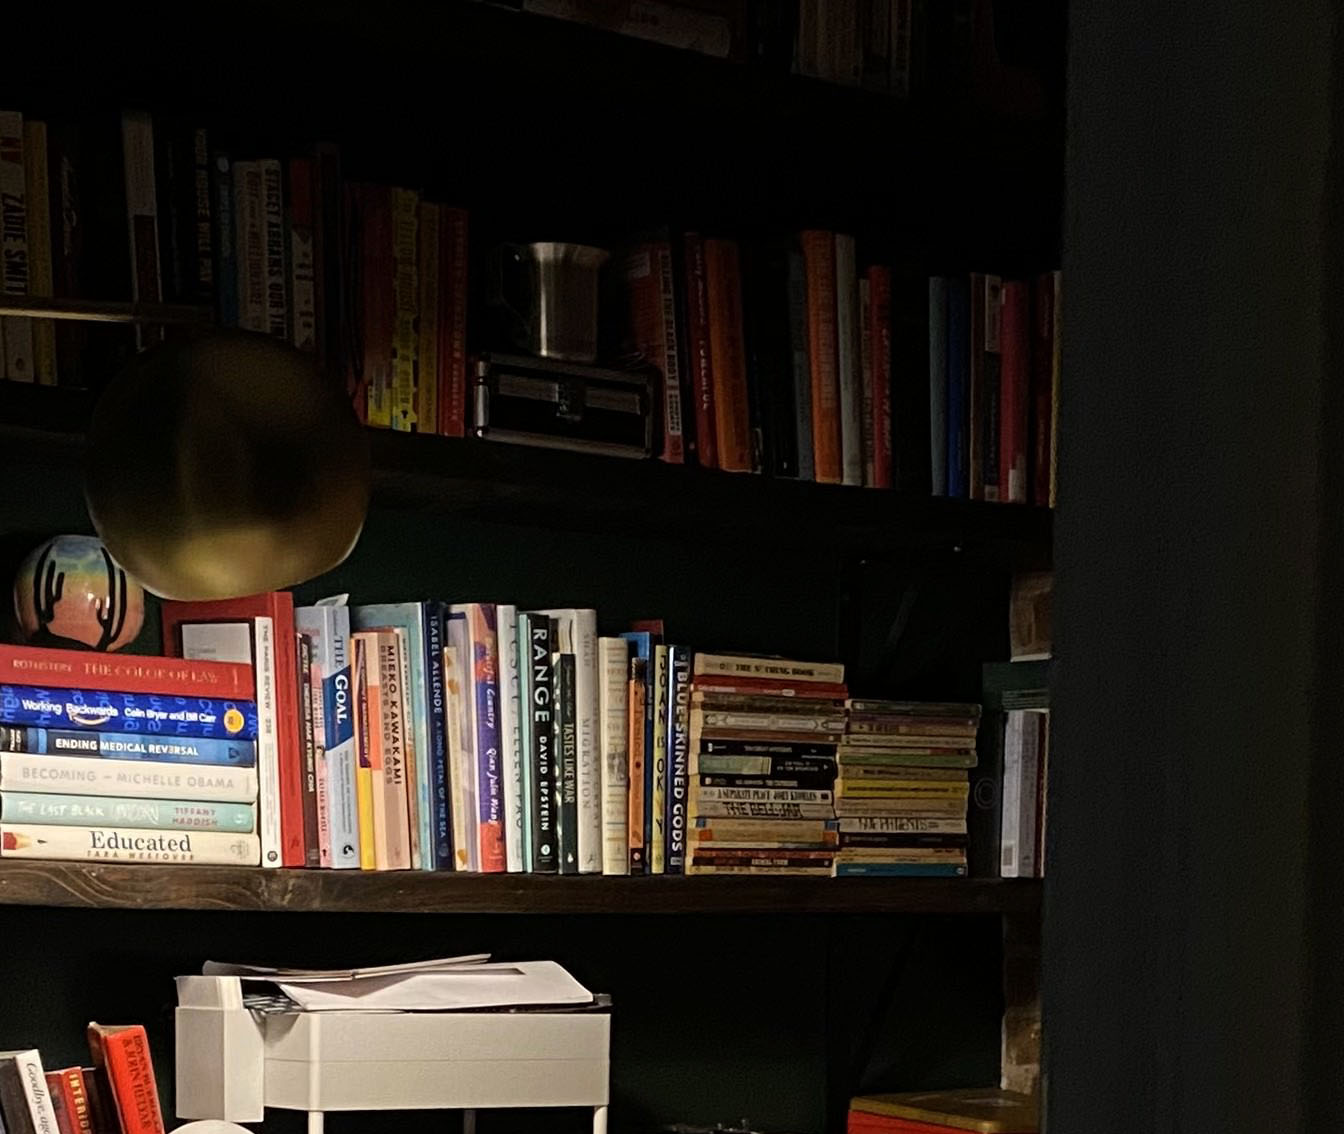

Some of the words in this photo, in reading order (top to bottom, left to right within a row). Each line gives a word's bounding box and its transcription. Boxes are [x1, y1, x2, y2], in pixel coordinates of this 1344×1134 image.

[334, 636, 345, 668] THE
[431, 616, 439, 656] ISABEL
[84, 663, 112, 676] THE
[387, 646, 397, 693] MIEKO
[533, 628, 550, 722] RANGE
[335, 675, 349, 724] GOAL
[432, 661, 442, 713] ALLENDE
[21, 699, 62, 716] Working
[66, 703, 118, 717] Backwards
[169, 710, 185, 720] and
[185, 710, 198, 721] Bill
[486, 689, 496, 729] Country
[56, 738, 97, 752] ENDING
[99, 740, 146, 754] MEDICAL
[390, 701, 402, 784] KAWAKAMI
[563, 724, 575, 756] TASTES
[674, 671, 689, 798] BLUE-SKINNED
[385, 749, 393, 784] EGGS
[486, 748, 497, 771] Qian
[539, 736, 548, 774] DAVID
[564, 758, 575, 779] LIKE
[581, 719, 591, 809] MIGRATION
[22, 767, 96, 782] BECOMING
[116, 773, 180, 786] MICHELLE
[187, 777, 234, 789] OBAMA
[564, 780, 575, 804] WAR
[18, 801, 36, 812] THE
[40, 803, 67, 816] LAST
[173, 807, 215, 816] TIFFANY
[488, 798, 500, 825] Wang
[540, 781, 550, 831] EPSTEIN
[722, 802, 749, 815] THE
[750, 803, 778, 816] BELL
[89, 829, 192, 852] Educated
[672, 803, 684, 851] GODS
[87, 849, 119, 860] TARA
[122, 1038, 130, 1047] &
